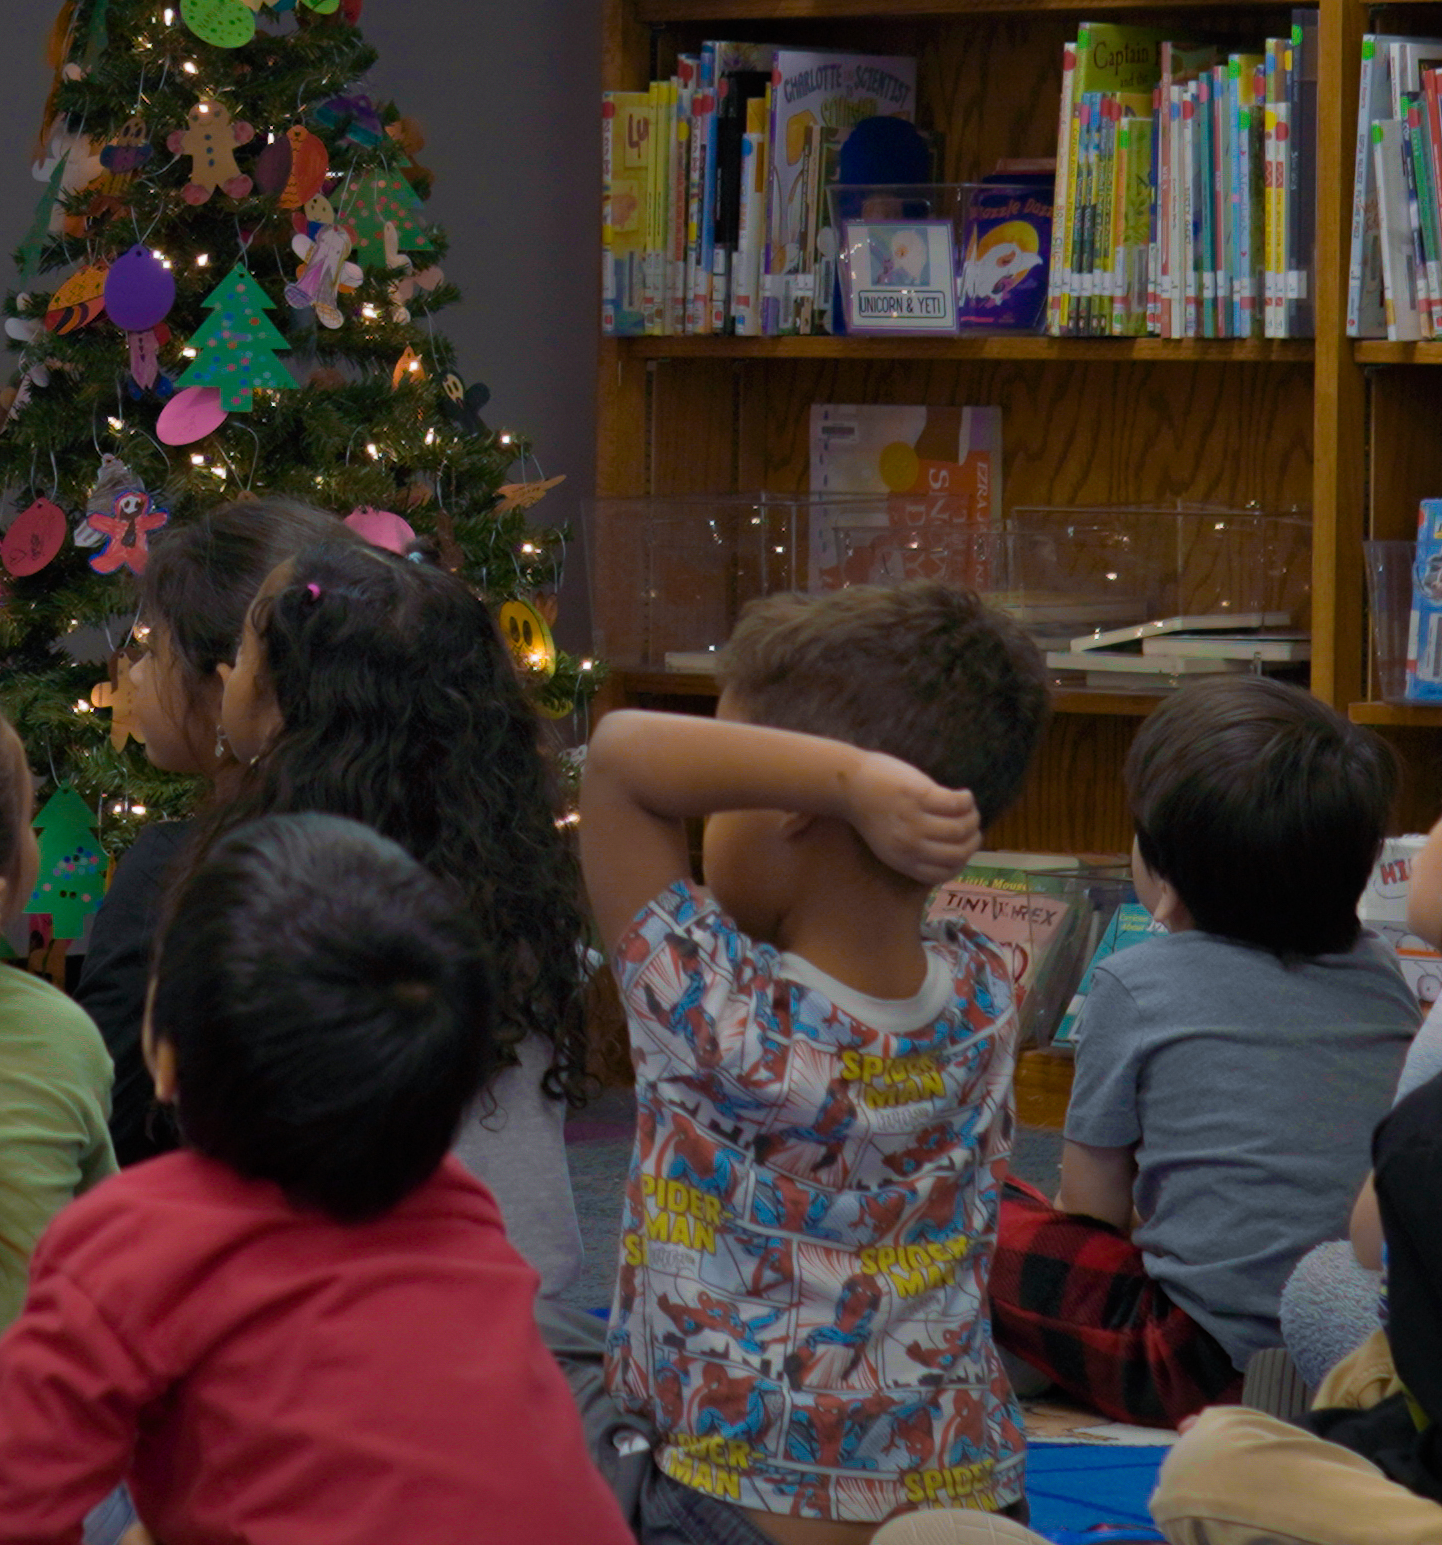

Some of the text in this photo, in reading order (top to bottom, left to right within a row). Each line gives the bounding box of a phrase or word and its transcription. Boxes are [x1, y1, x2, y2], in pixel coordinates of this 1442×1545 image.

[1093, 42, 1149, 70] Captain
[783, 63, 912, 106] CHARLOTTE SCIENTIST
[859, 293, 941, 315] UNICORN & YETI
[956, 874, 989, 890] Little
[944, 893, 989, 916] TINY
[644, 1211, 715, 1255] MAN
[665, 1459, 740, 1500] MAN
